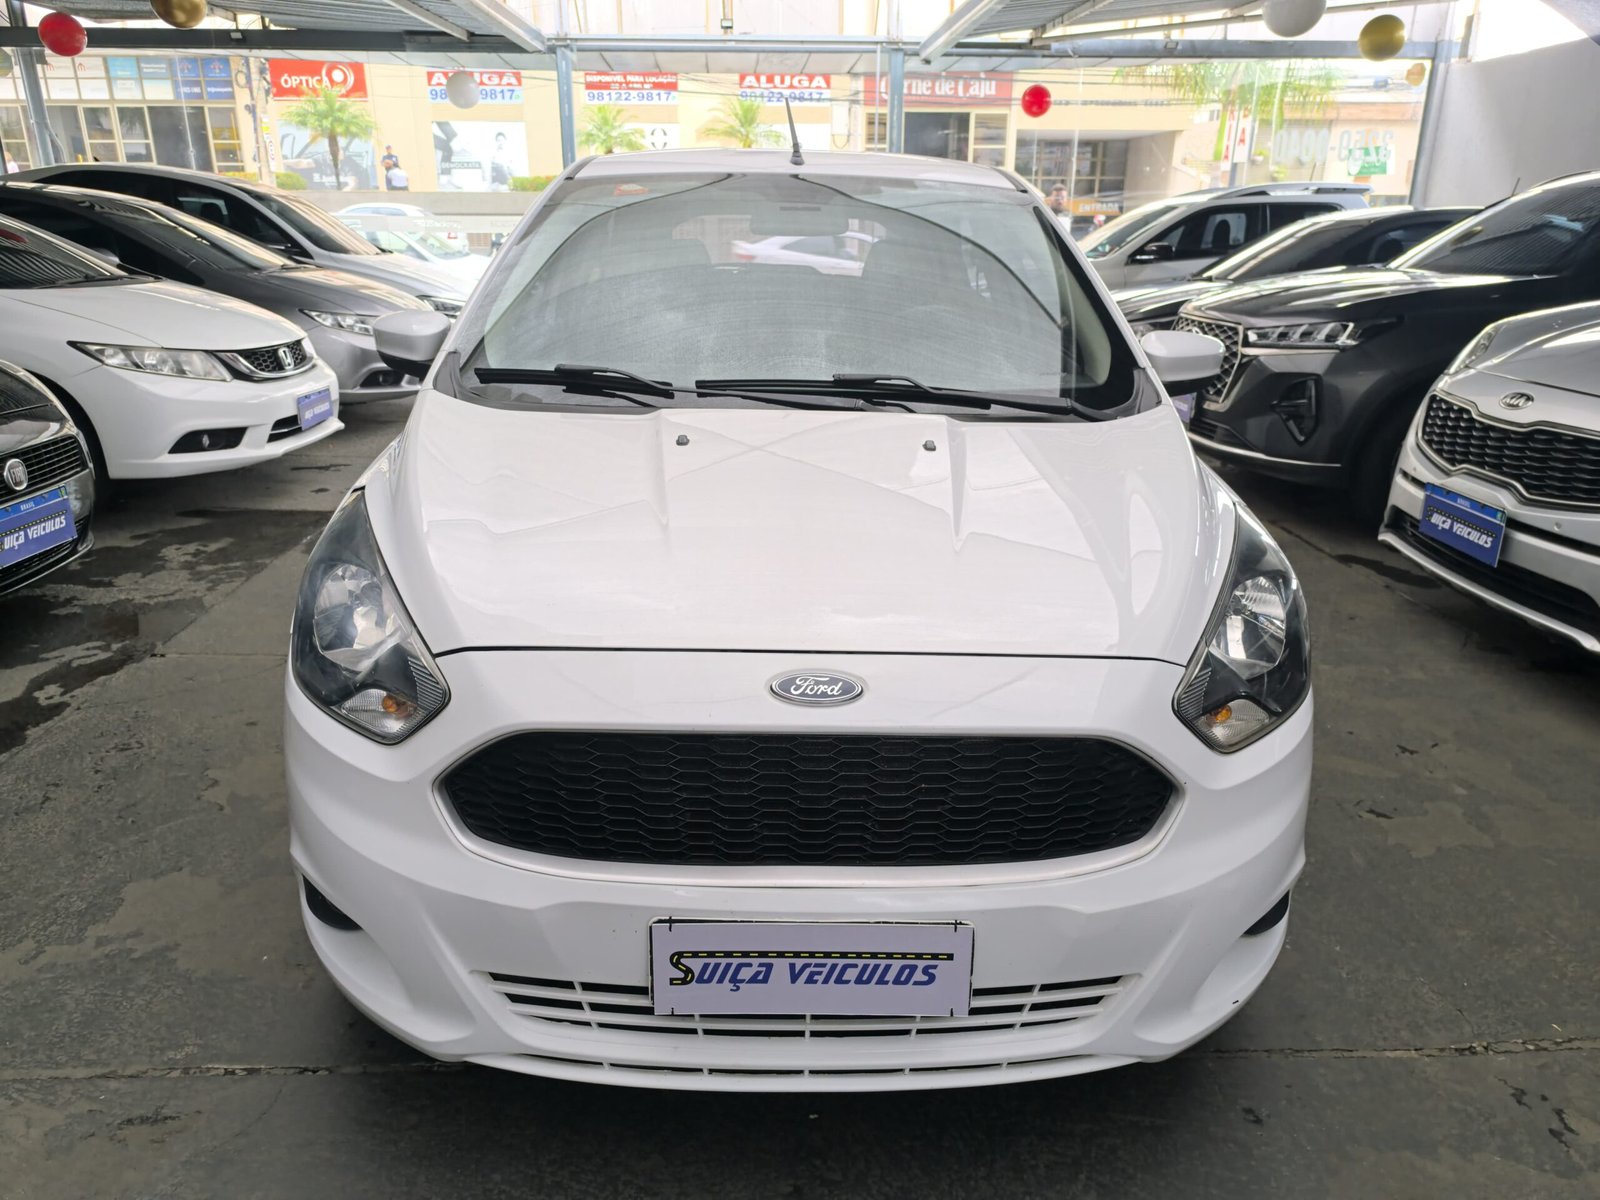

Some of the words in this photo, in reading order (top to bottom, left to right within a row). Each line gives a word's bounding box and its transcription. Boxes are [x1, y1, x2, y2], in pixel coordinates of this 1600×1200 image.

[280, 73, 332, 90] ÓPTICA
[430, 72, 519, 85] AGA
[741, 74, 828, 88] ALUGA
[880, 75, 932, 99] Crne
[935, 72, 954, 96] de
[429, 88, 515, 100] 989817
[587, 91, 672, 101] 98122-9817
[740, 90, 824, 103] 981229817
[0, 532, 25, 552] UIÇA
[790, 676, 843, 696] Ford
